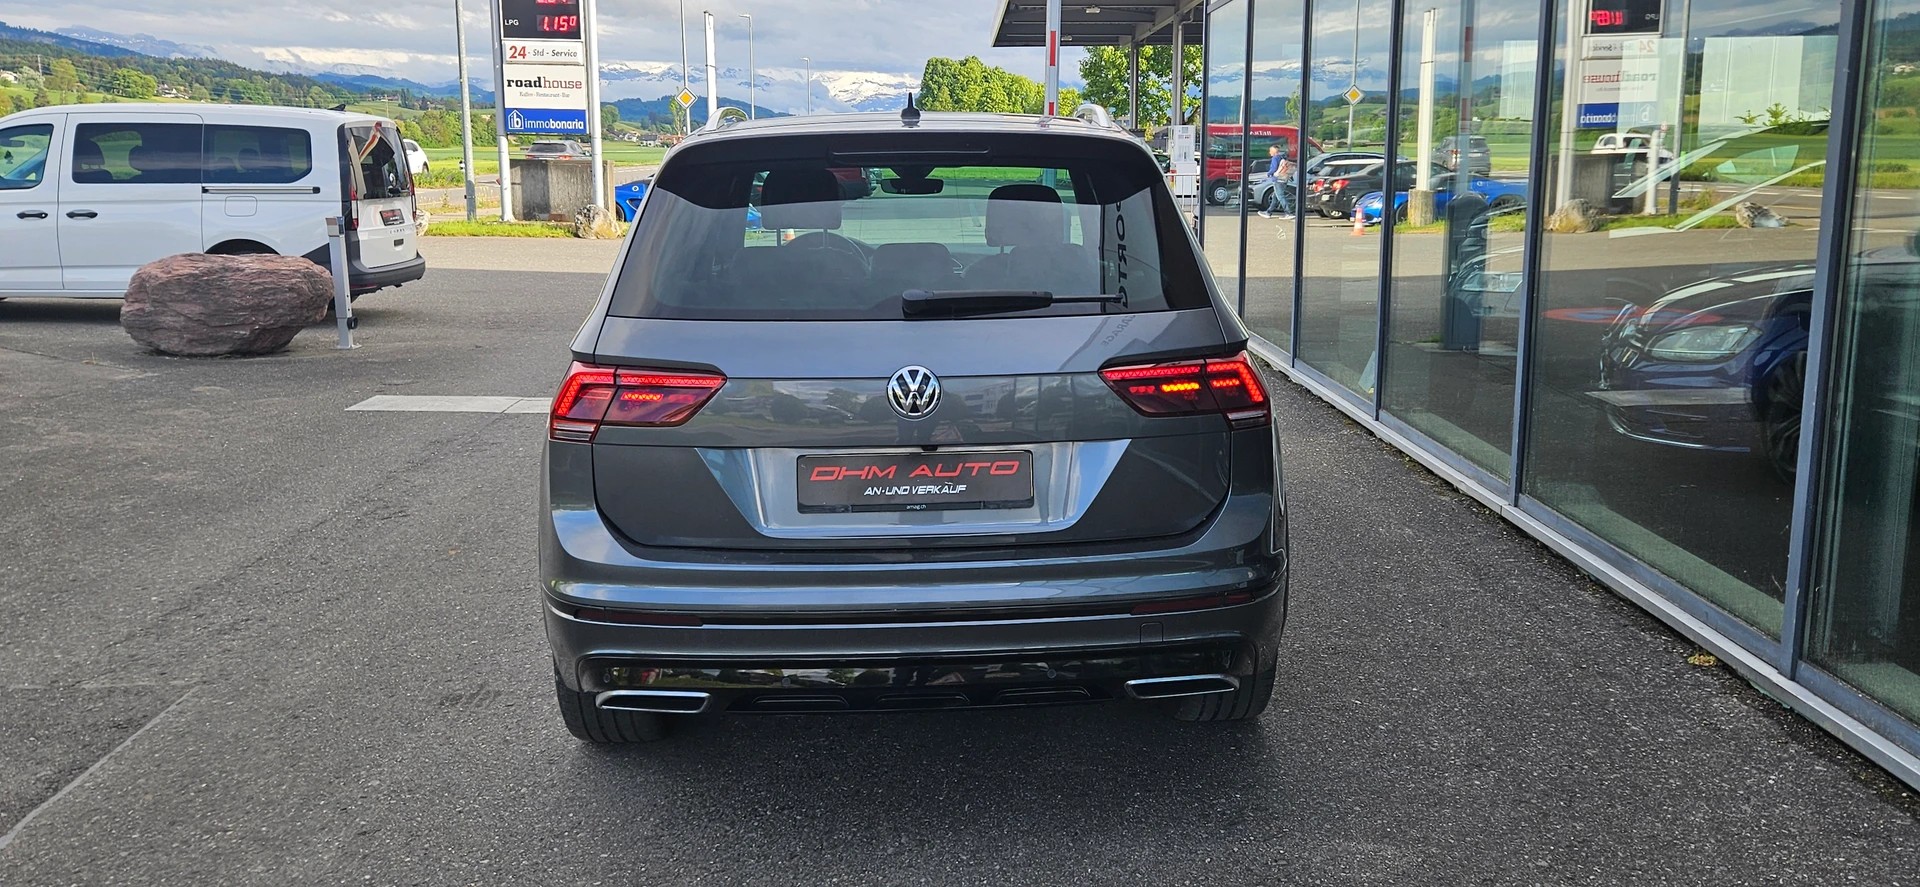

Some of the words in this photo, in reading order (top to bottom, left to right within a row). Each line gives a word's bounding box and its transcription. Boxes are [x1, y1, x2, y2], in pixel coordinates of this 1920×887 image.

[509, 45, 527, 59] 24
[532, 49, 545, 57] Std
[551, 49, 578, 57] Service
[506, 76, 583, 89] roadhouse
[525, 119, 584, 129] immobonaria
[810, 465, 897, 481] DHM
[909, 460, 1020, 478] AUTO
[912, 484, 967, 495] VERKAUF
